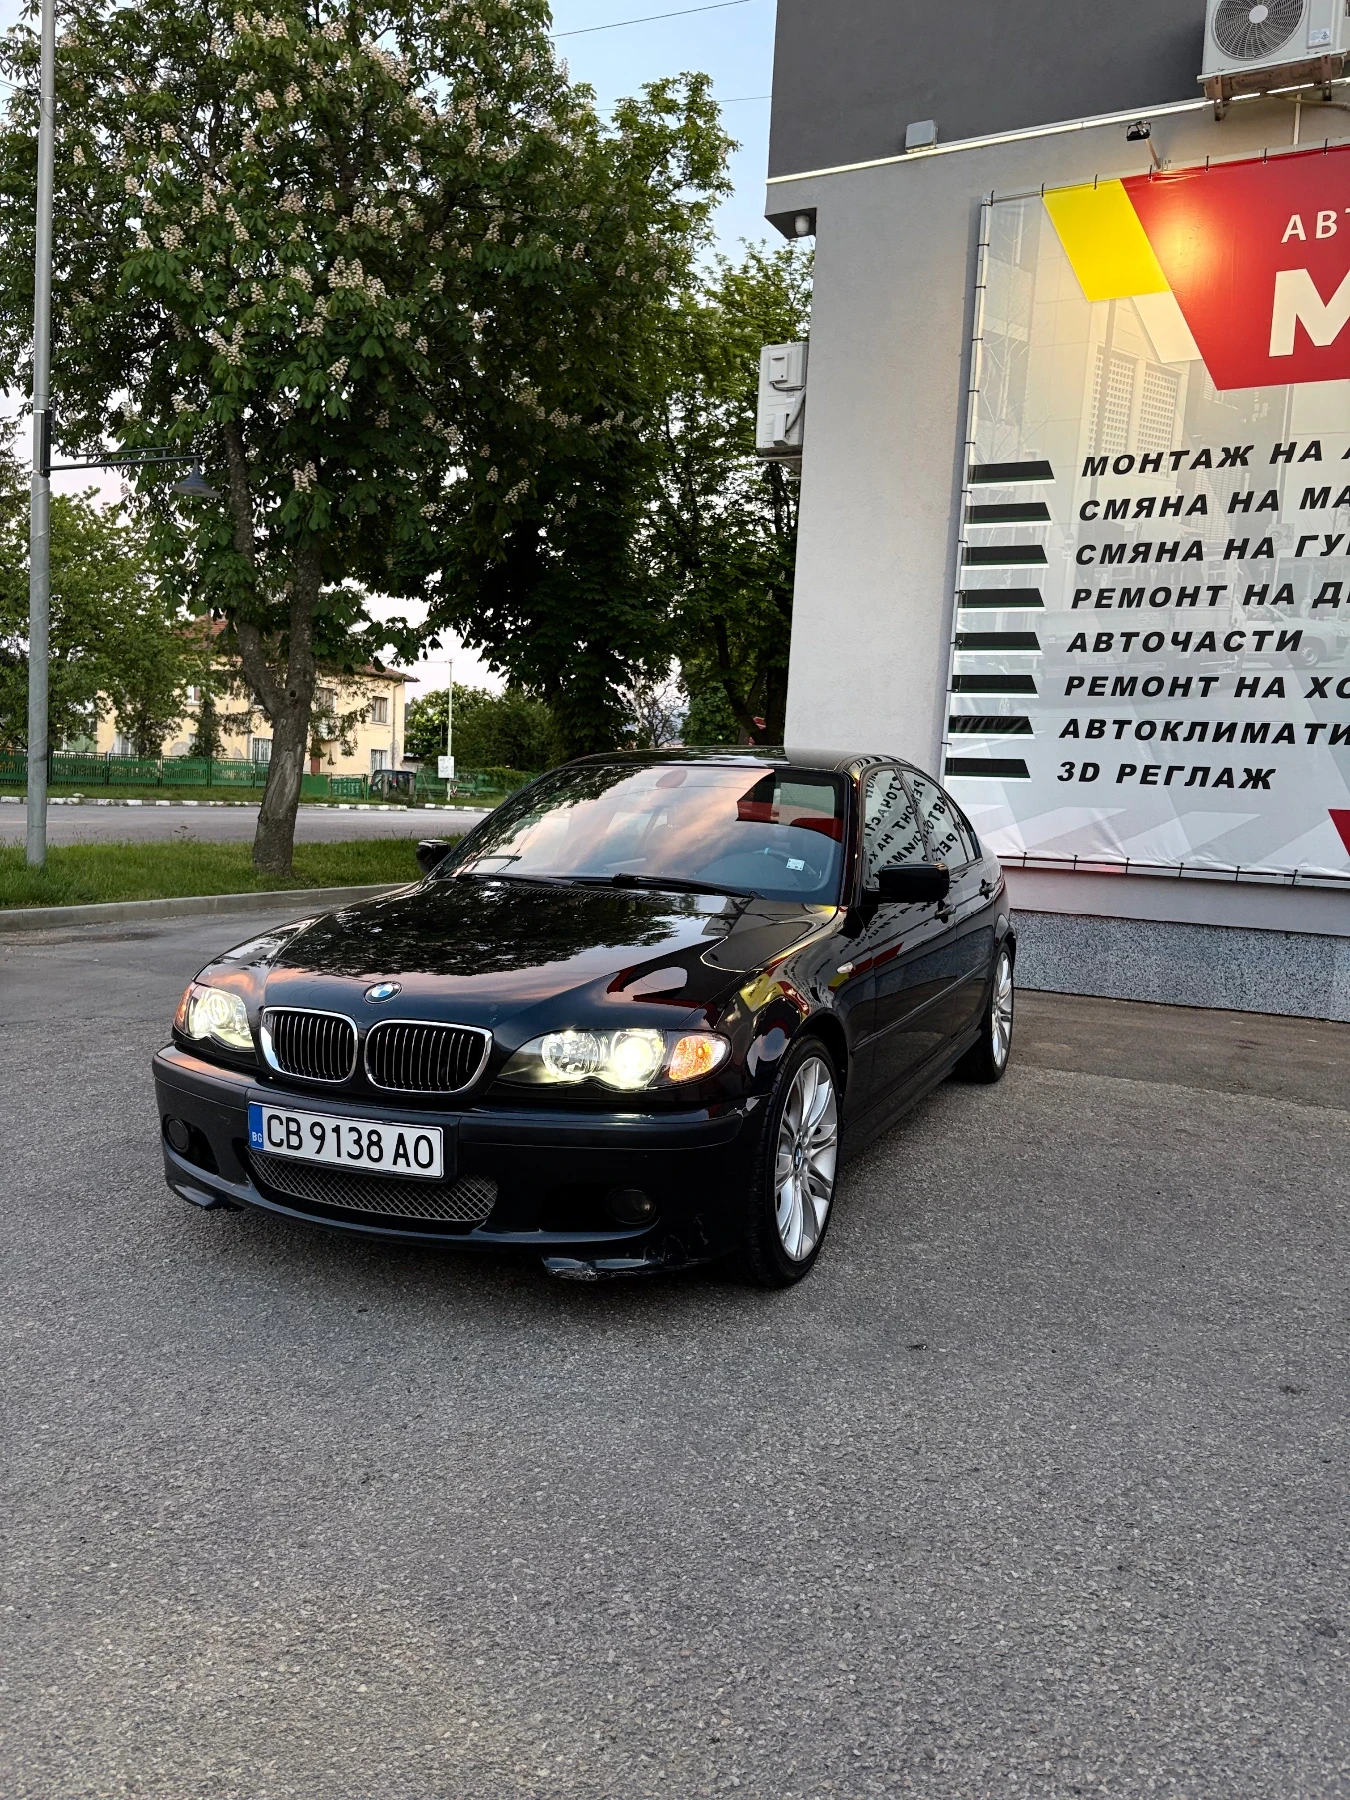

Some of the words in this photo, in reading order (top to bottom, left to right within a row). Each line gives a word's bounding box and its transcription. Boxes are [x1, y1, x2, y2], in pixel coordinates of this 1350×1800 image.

[1081, 445, 1254, 477] МОНТАЖ
[1269, 440, 1322, 465] НА
[1079, 494, 1208, 521] СМЯНА
[1227, 490, 1279, 513] НА
[1076, 540, 1204, 565] СМЯНА
[1223, 537, 1274, 560] НА
[1294, 534, 1350, 557] ГУ
[1071, 585, 1228, 609] РЕМОНТ
[1242, 583, 1295, 606] НА
[1311, 581, 1350, 609] Д
[1066, 630, 1303, 653] АВТОЧАСТИ
[1064, 676, 1219, 698] РЕМОНТ
[1234, 676, 1286, 698] НА
[1057, 761, 1100, 783] 3D
[1115, 763, 1276, 790] РЕГЛАЖ
[252, 1131, 263, 1143] BG
[267, 1114, 303, 1150] CB
[309, 1121, 384, 1163] 9138
[392, 1132, 434, 1169] AO
